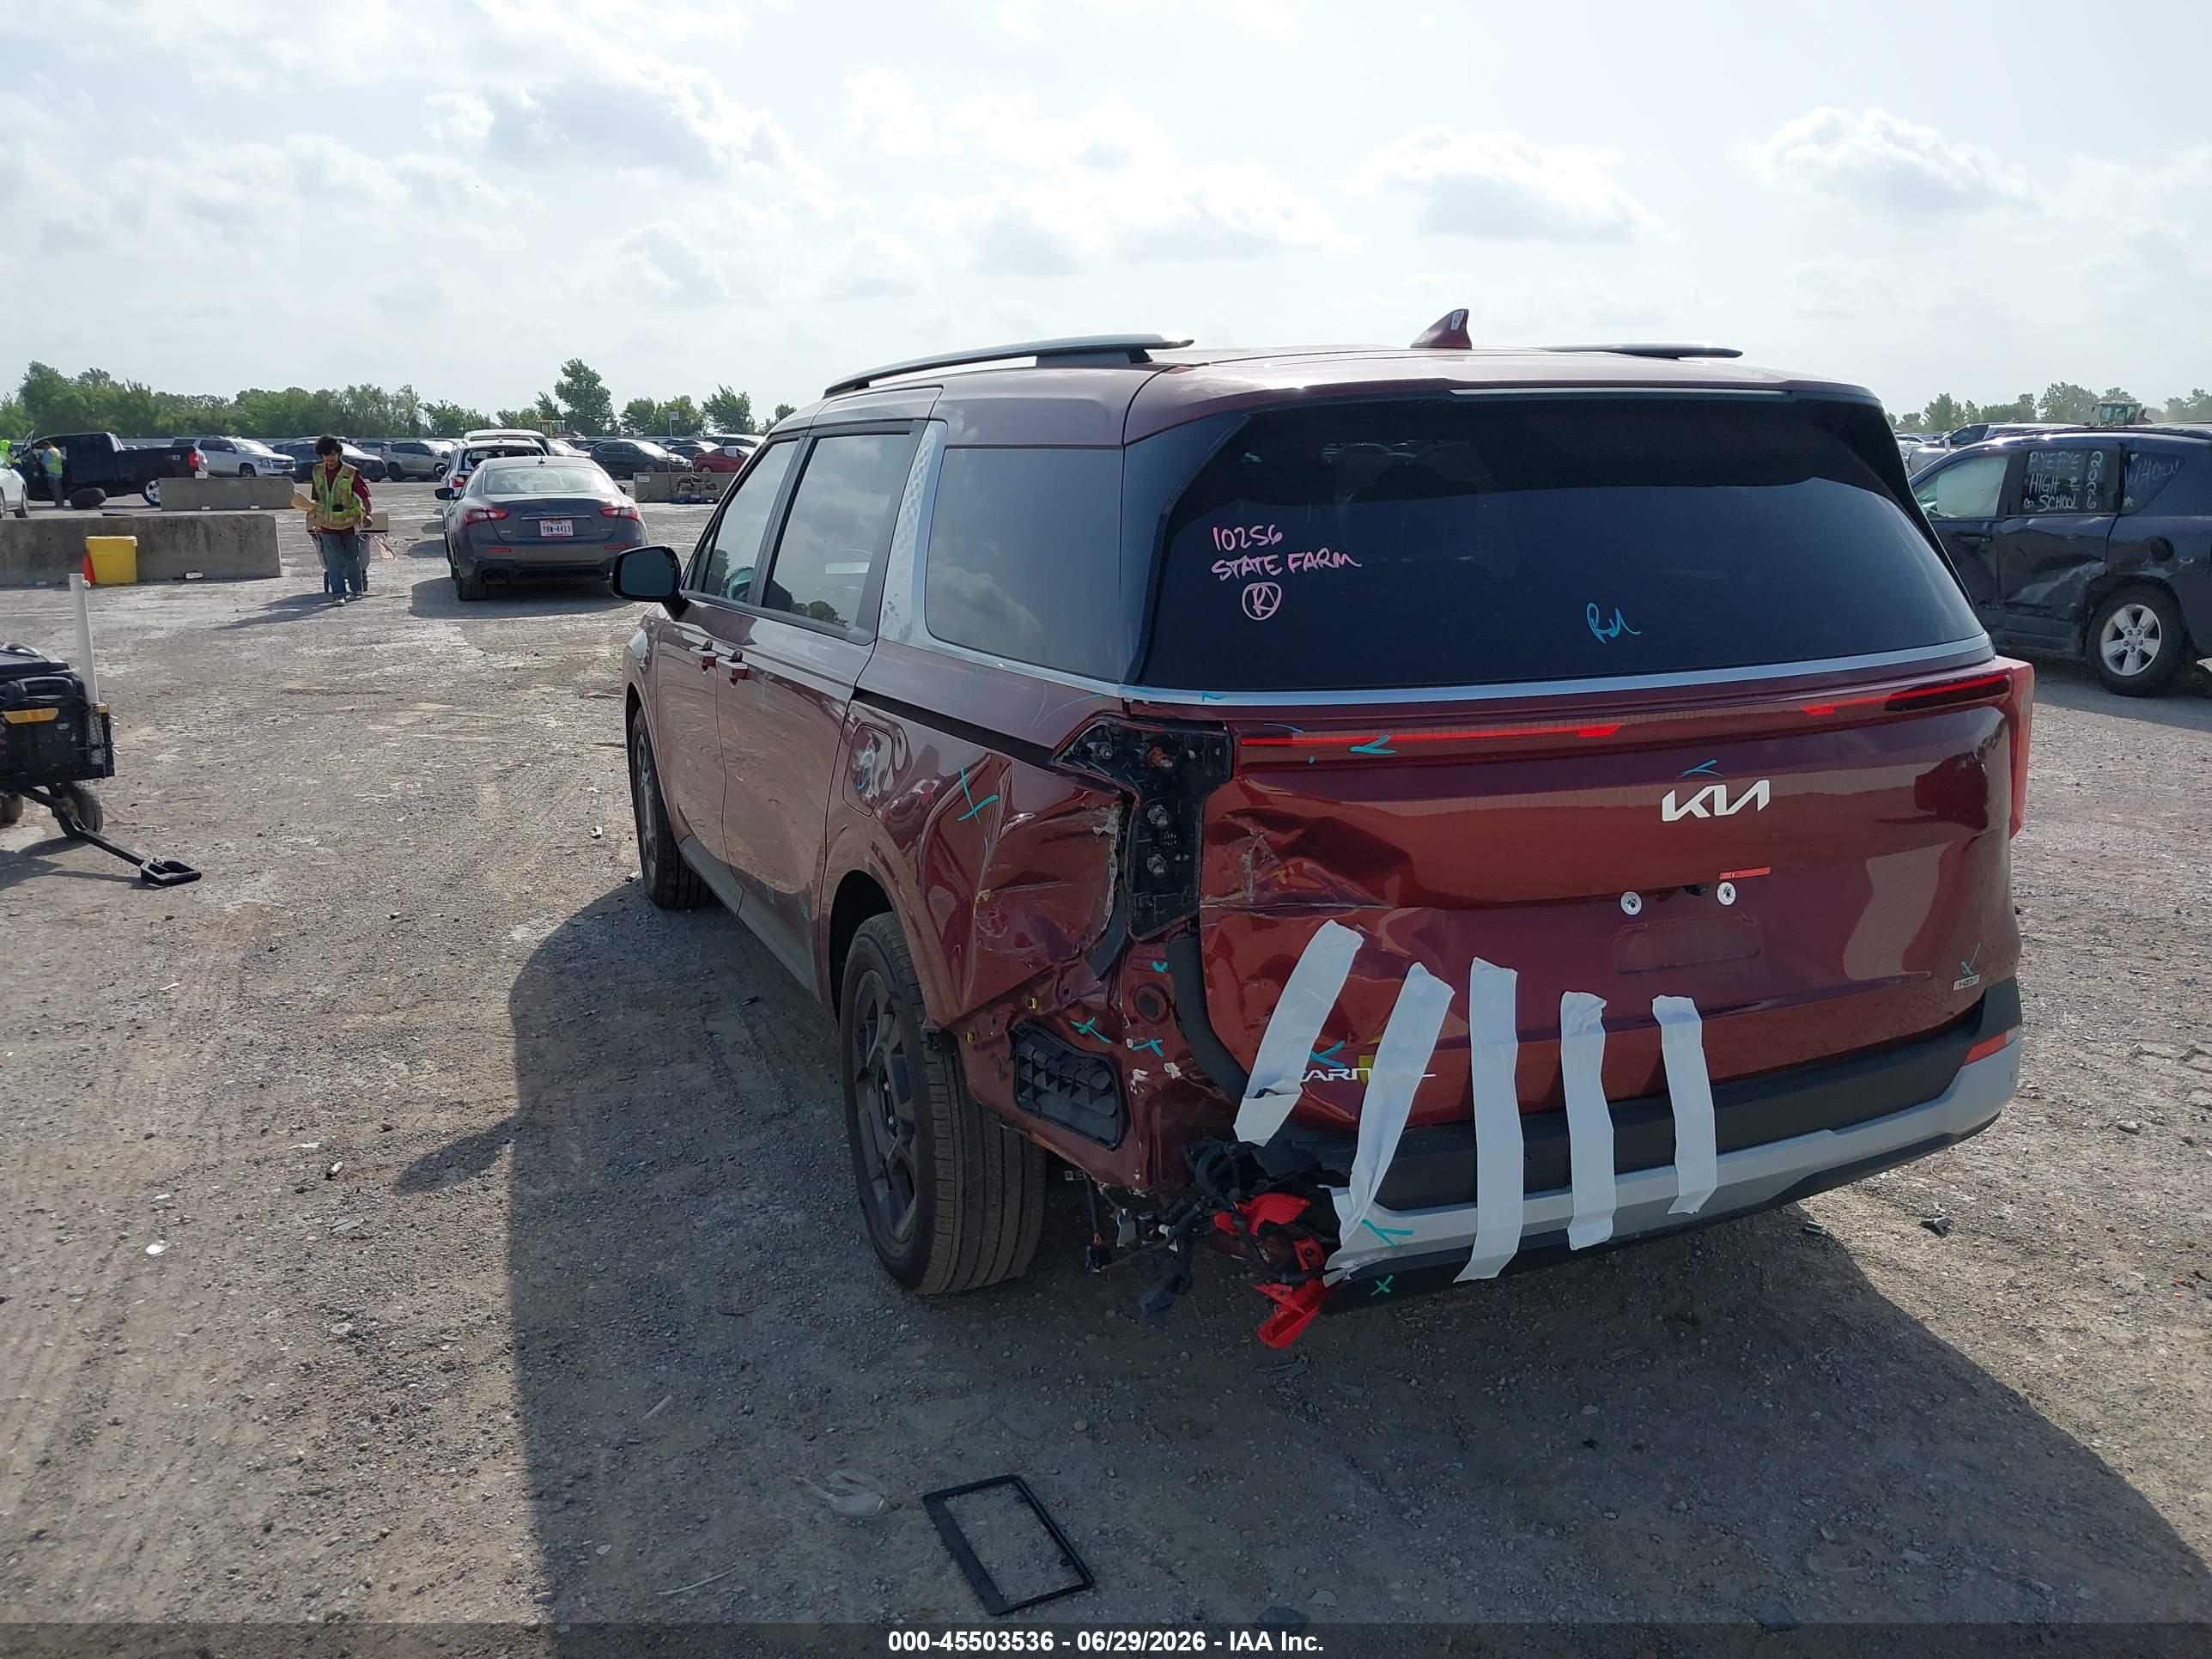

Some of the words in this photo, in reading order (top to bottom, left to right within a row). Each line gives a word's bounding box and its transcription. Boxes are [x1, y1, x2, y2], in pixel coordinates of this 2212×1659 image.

[2029, 473, 2060, 495] HIGH
[2036, 493, 2079, 513] SCHOOL
[1212, 524, 1283, 551] 10256
[1211, 554, 1283, 581] STATE
[1287, 547, 1363, 574] FARM
[1662, 780, 1770, 822] KIA
